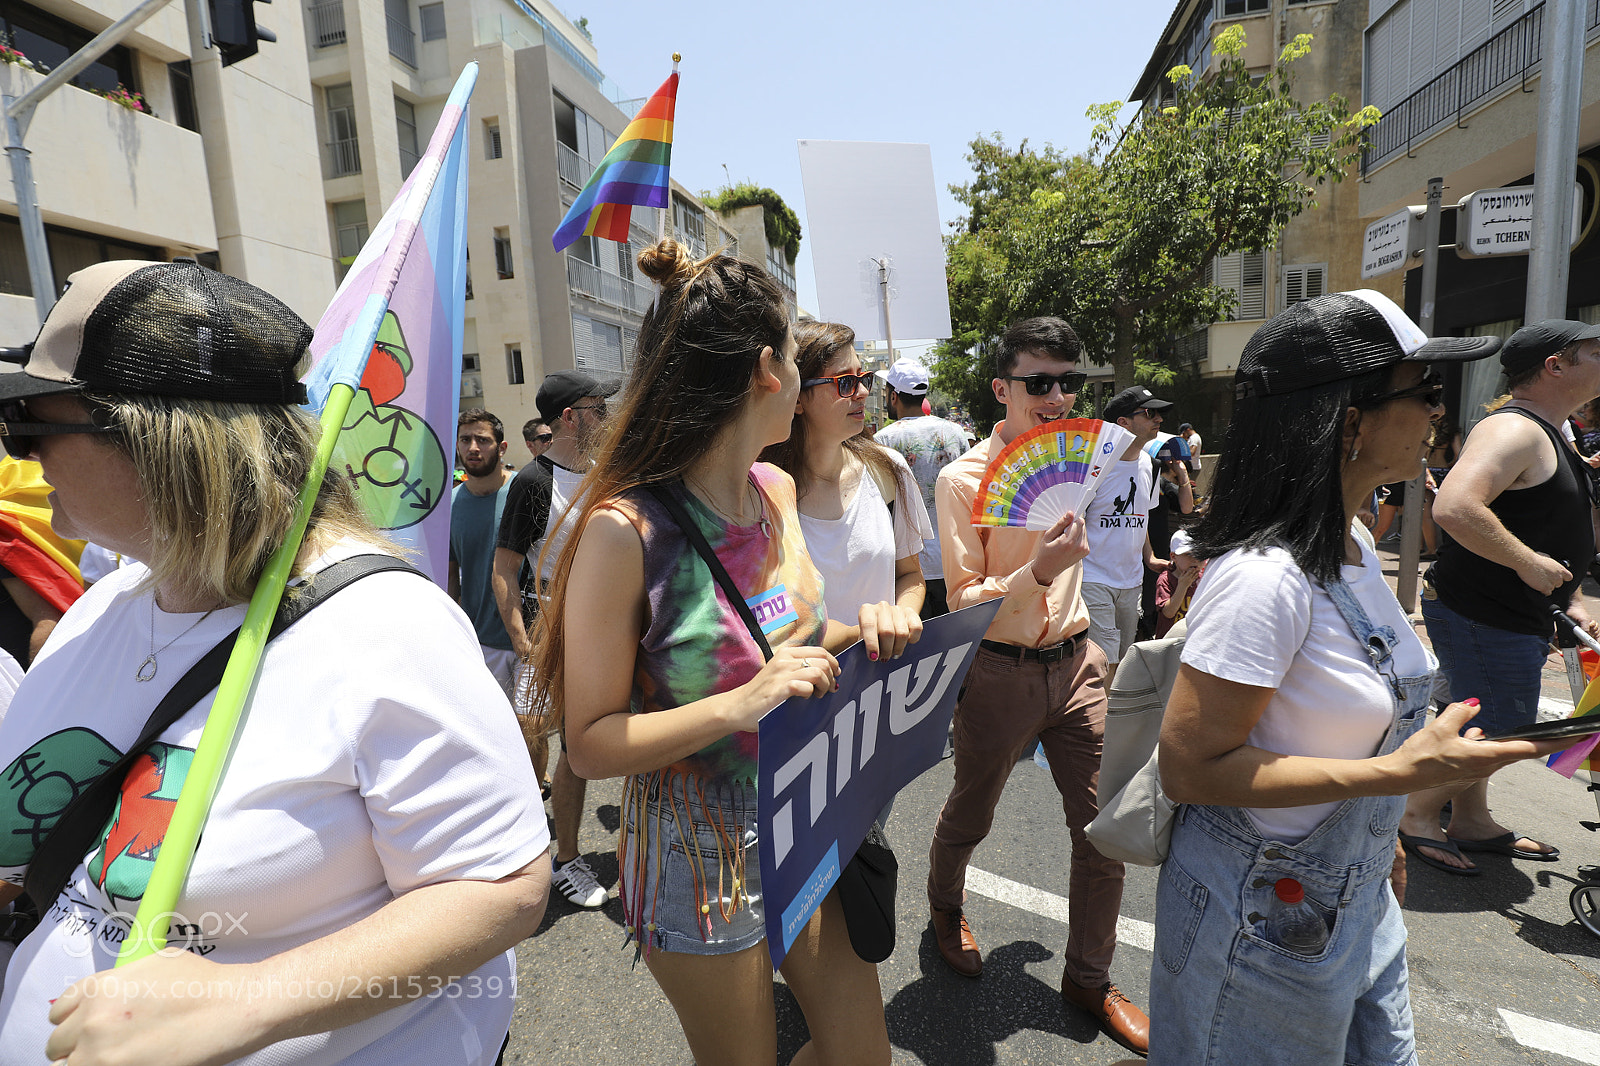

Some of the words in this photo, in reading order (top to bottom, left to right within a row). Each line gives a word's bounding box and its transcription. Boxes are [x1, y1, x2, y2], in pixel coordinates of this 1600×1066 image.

[988, 450, 1032, 496] Protect
[1011, 472, 1029, 491] Don't
[1028, 461, 1050, 476] Sweat
[1050, 458, 1057, 466] it
[1100, 517, 1121, 528] גאה
[1125, 517, 1144, 528] אבא
[772, 641, 973, 871] שווה
